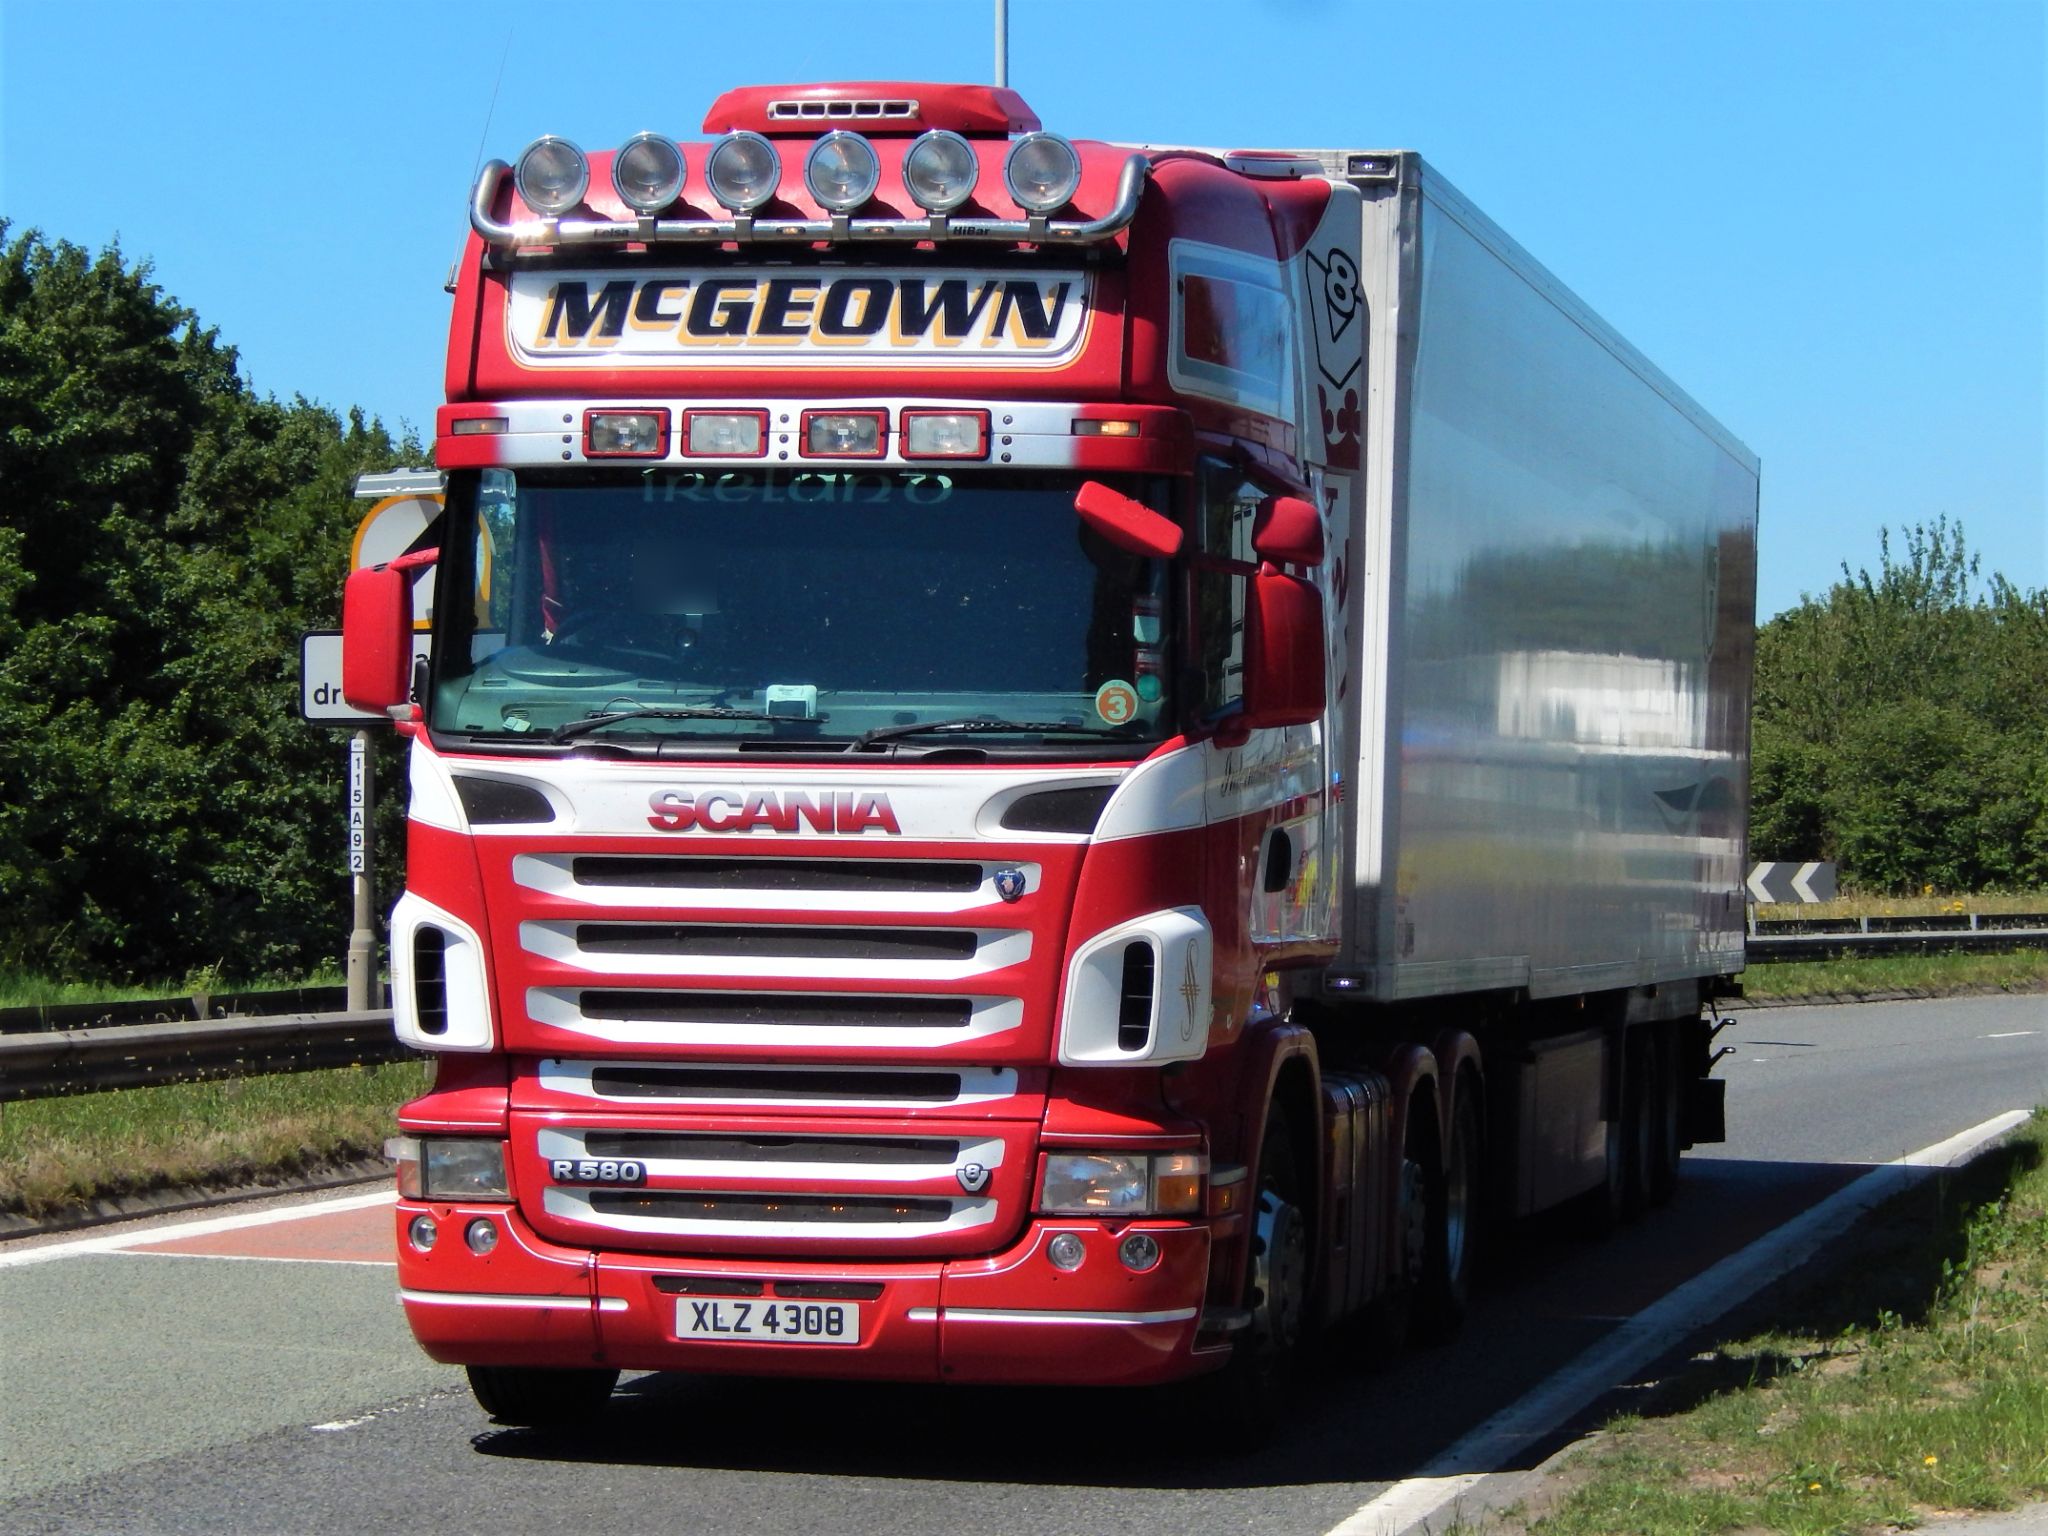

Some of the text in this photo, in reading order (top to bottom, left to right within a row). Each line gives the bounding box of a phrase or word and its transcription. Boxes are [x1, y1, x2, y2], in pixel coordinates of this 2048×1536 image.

[952, 226, 990, 236] HiBar
[1107, 695, 1128, 720] 3
[647, 789, 901, 835] SCANIA
[691, 1302, 844, 1336] XLZ 4308
